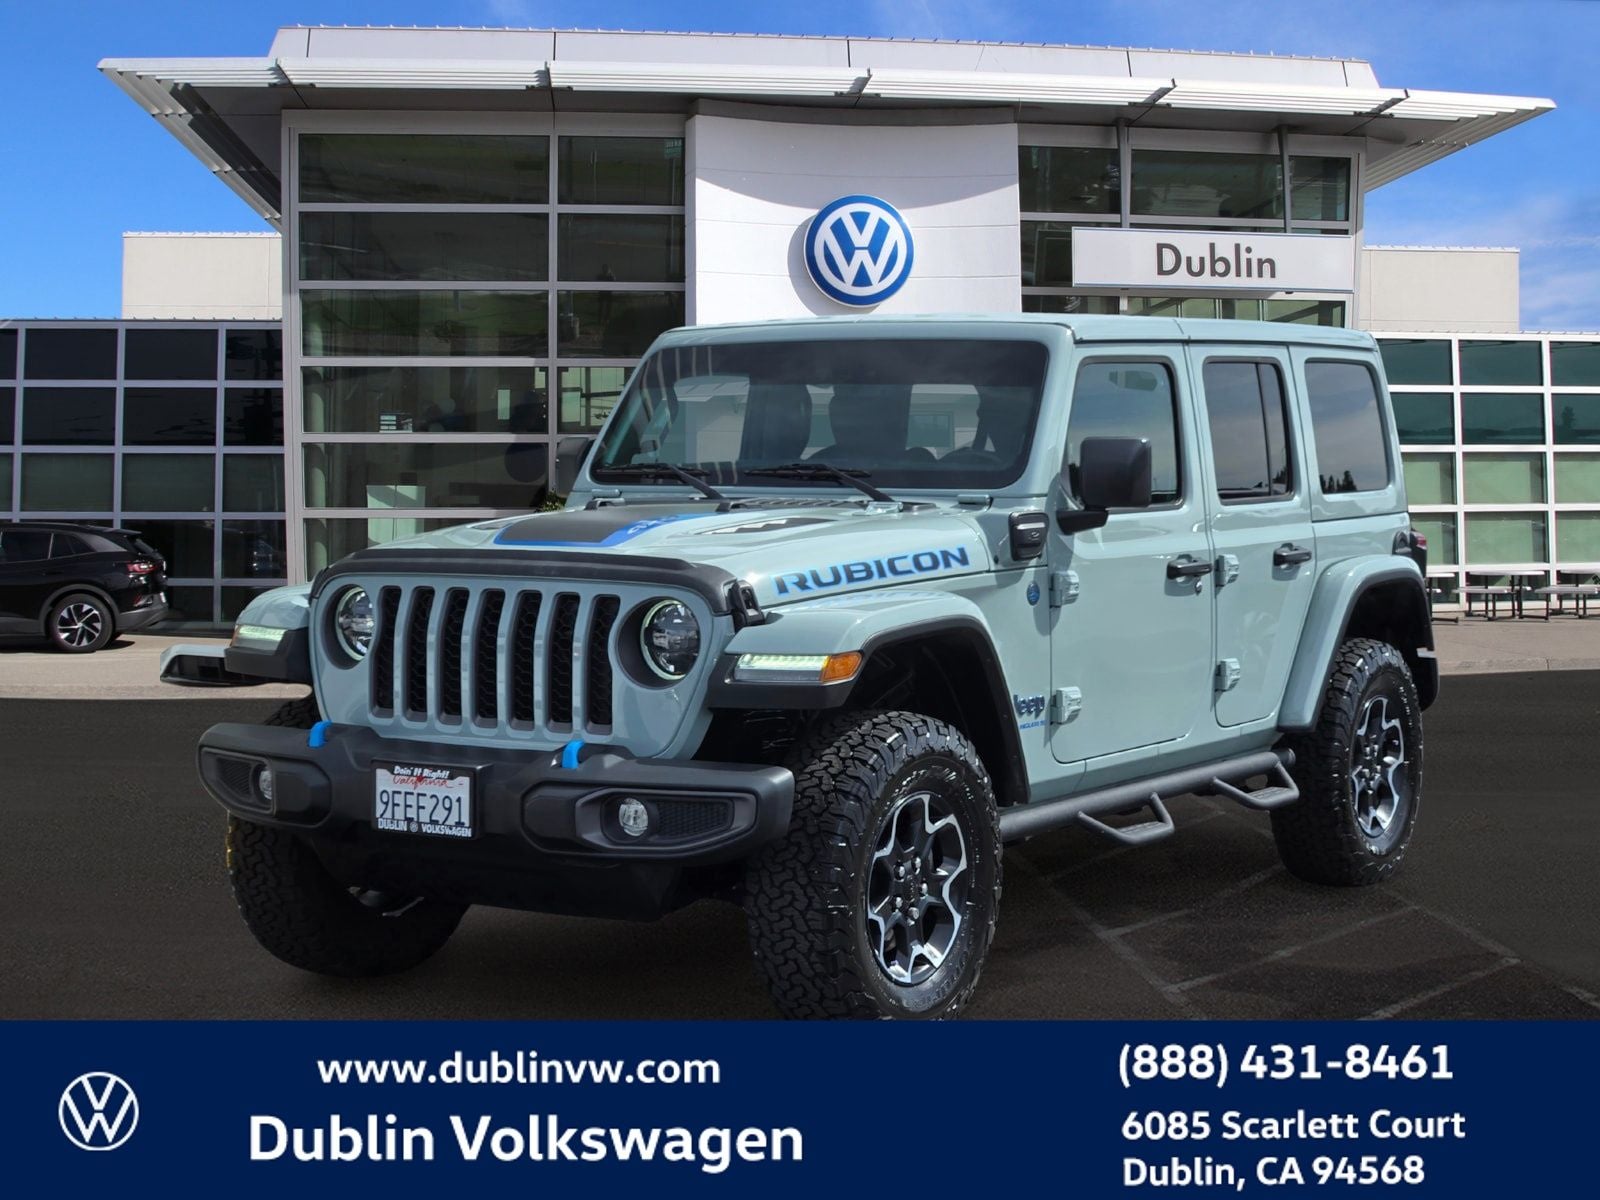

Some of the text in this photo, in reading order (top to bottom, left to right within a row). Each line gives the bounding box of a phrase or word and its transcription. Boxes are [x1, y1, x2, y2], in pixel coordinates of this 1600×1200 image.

[1156, 242, 1276, 278] Dublin
[772, 546, 970, 596] RUBICON
[380, 790, 465, 825] 9FEF291
[378, 818, 407, 831] DUBLIN
[421, 823, 472, 837] VOLKSWAGEN
